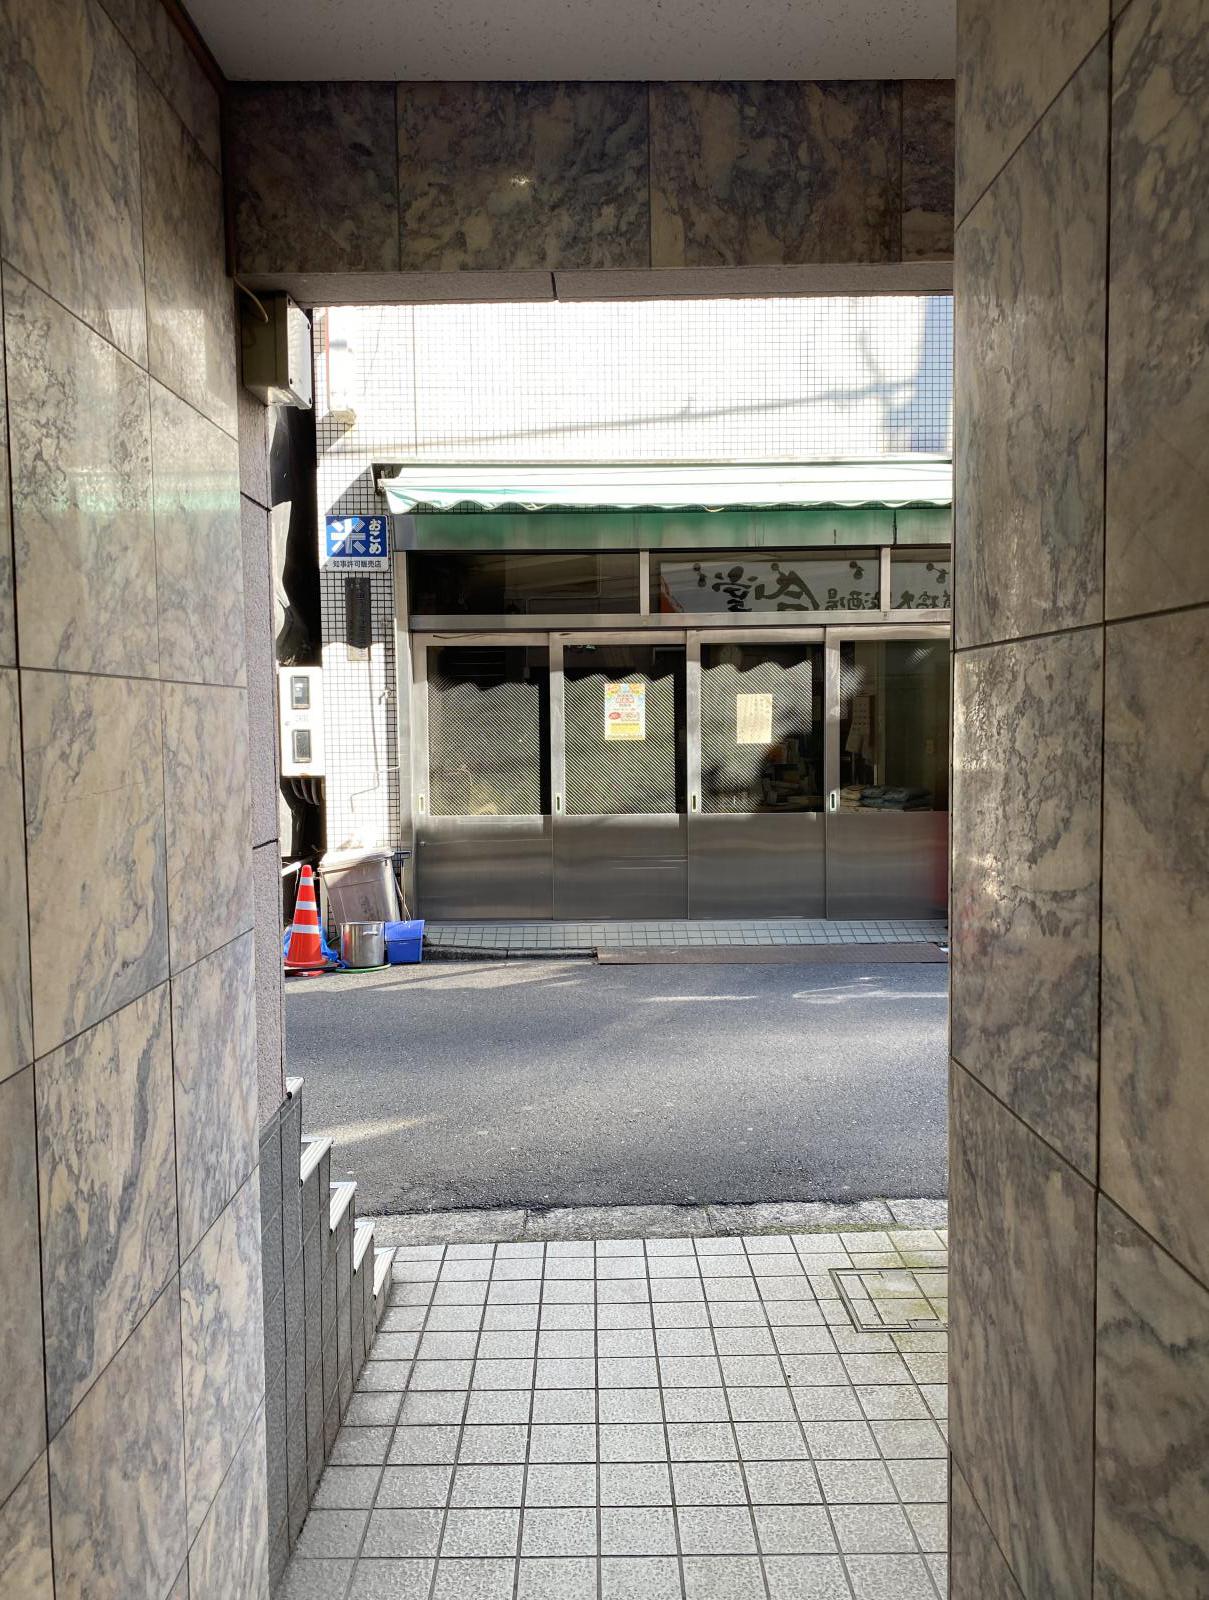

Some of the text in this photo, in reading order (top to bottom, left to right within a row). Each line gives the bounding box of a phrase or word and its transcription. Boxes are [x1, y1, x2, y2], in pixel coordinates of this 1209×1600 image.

[368, 518, 382, 554] おこめ
[332, 560, 382, 569] 知事許可販売店
